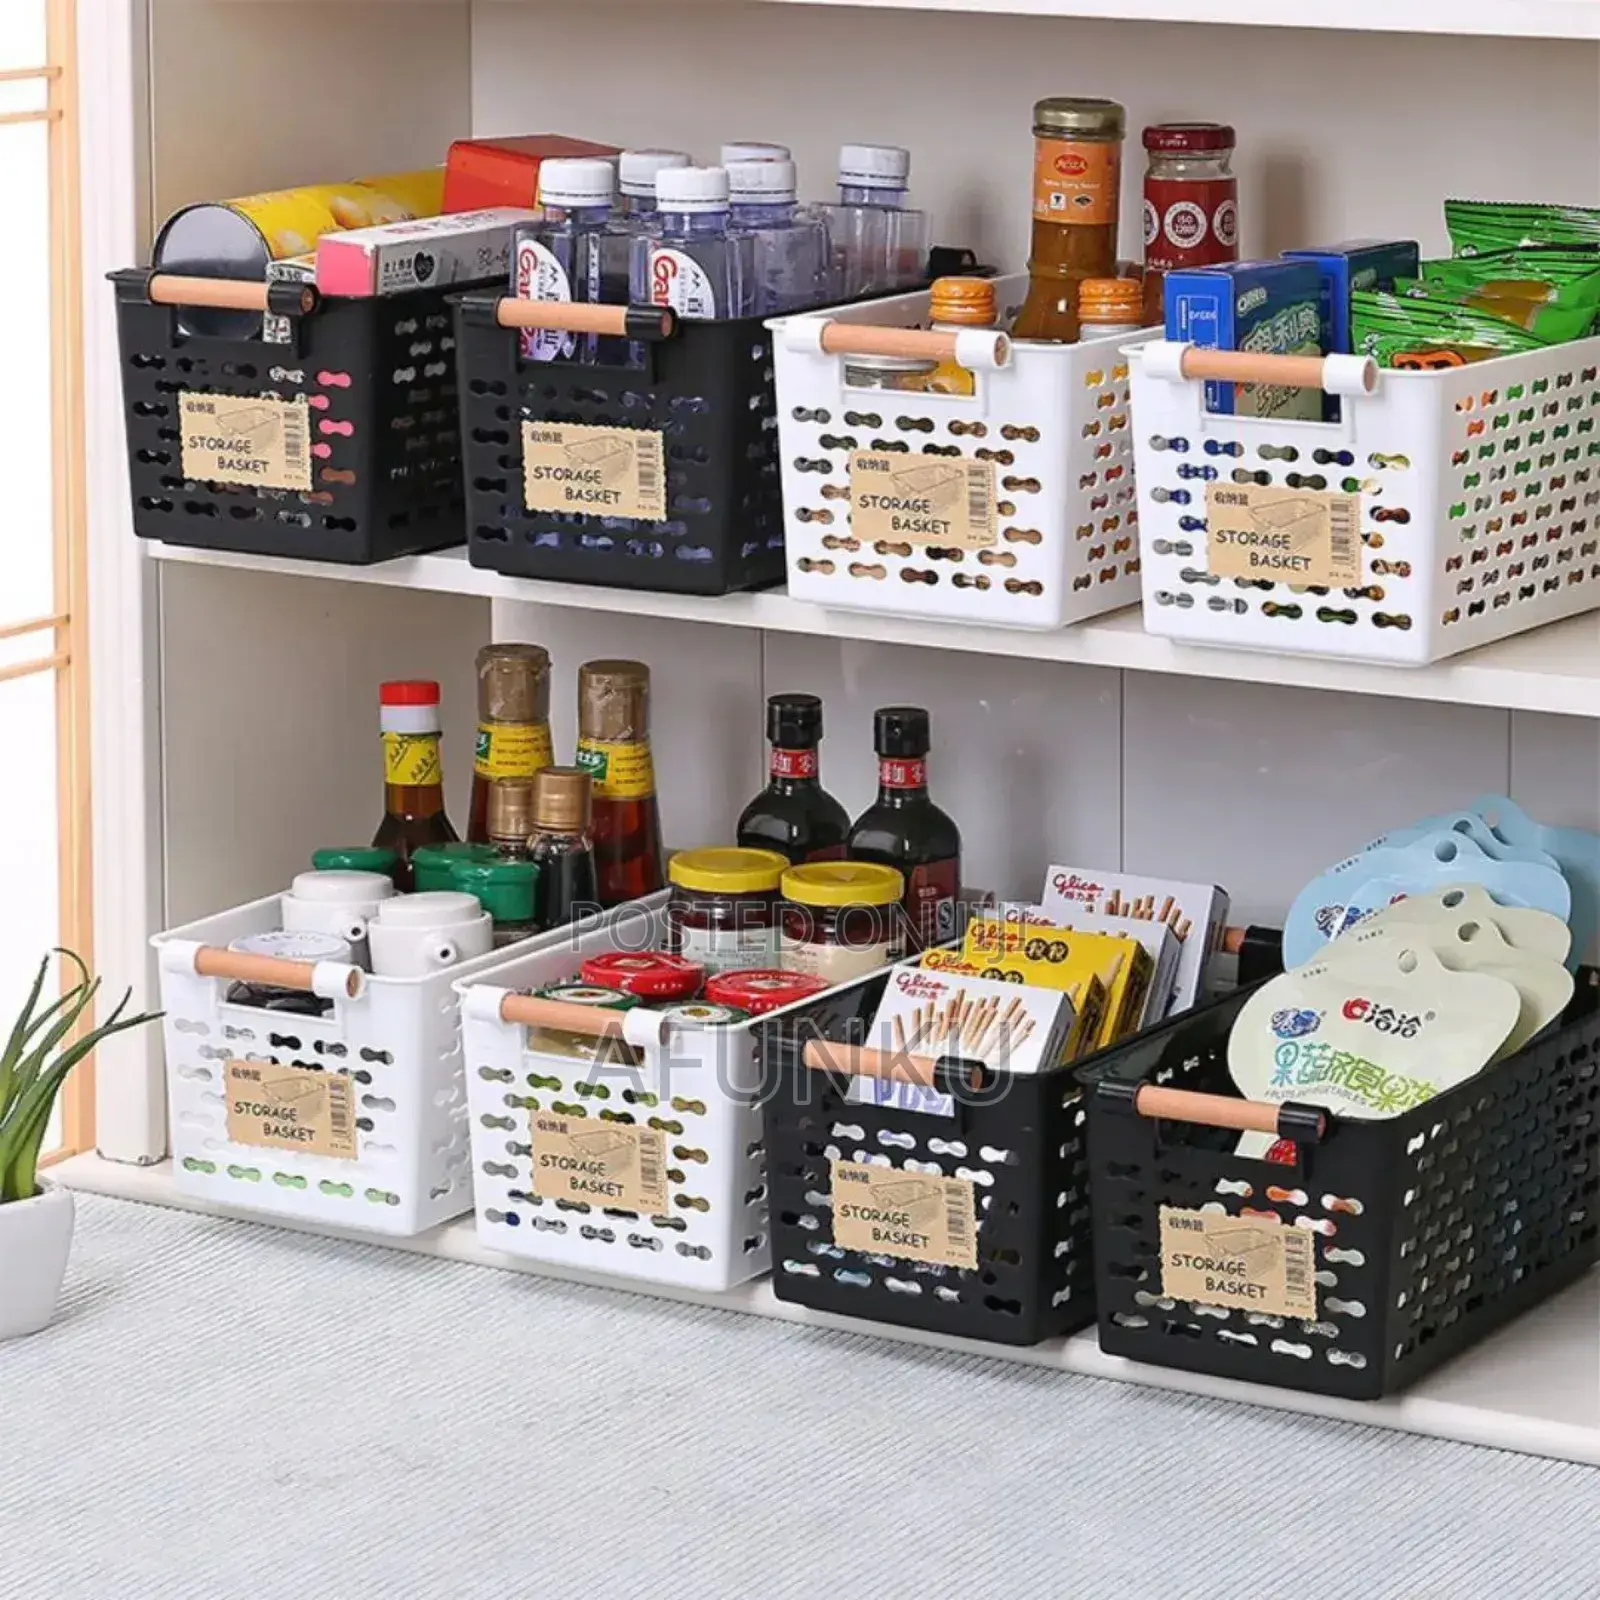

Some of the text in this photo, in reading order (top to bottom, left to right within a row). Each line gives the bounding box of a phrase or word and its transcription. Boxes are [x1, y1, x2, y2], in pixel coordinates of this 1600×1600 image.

[189, 436, 252, 454] STORAGE
[217, 456, 270, 473] BASKET
[533, 466, 602, 484] STORAGE
[565, 486, 622, 504] BASKET
[859, 494, 931, 514] STORAGE
[891, 515, 951, 534] BASKET
[1216, 529, 1291, 550] STORAGE
[1250, 552, 1311, 571] BASKET
[1052, 873, 1104, 894] Glico
[896, 972, 949, 991] Glico
[234, 1101, 297, 1121] STORAGE
[263, 1122, 316, 1141] BASKET
[540, 1154, 606, 1176] STORAGE
[570, 1176, 624, 1197] BASKET
[840, 1204, 911, 1228] STORAGE
[872, 1227, 930, 1249] BASKET
[1171, 1253, 1247, 1277] STORAGE
[1205, 1276, 1267, 1299] BASKET
